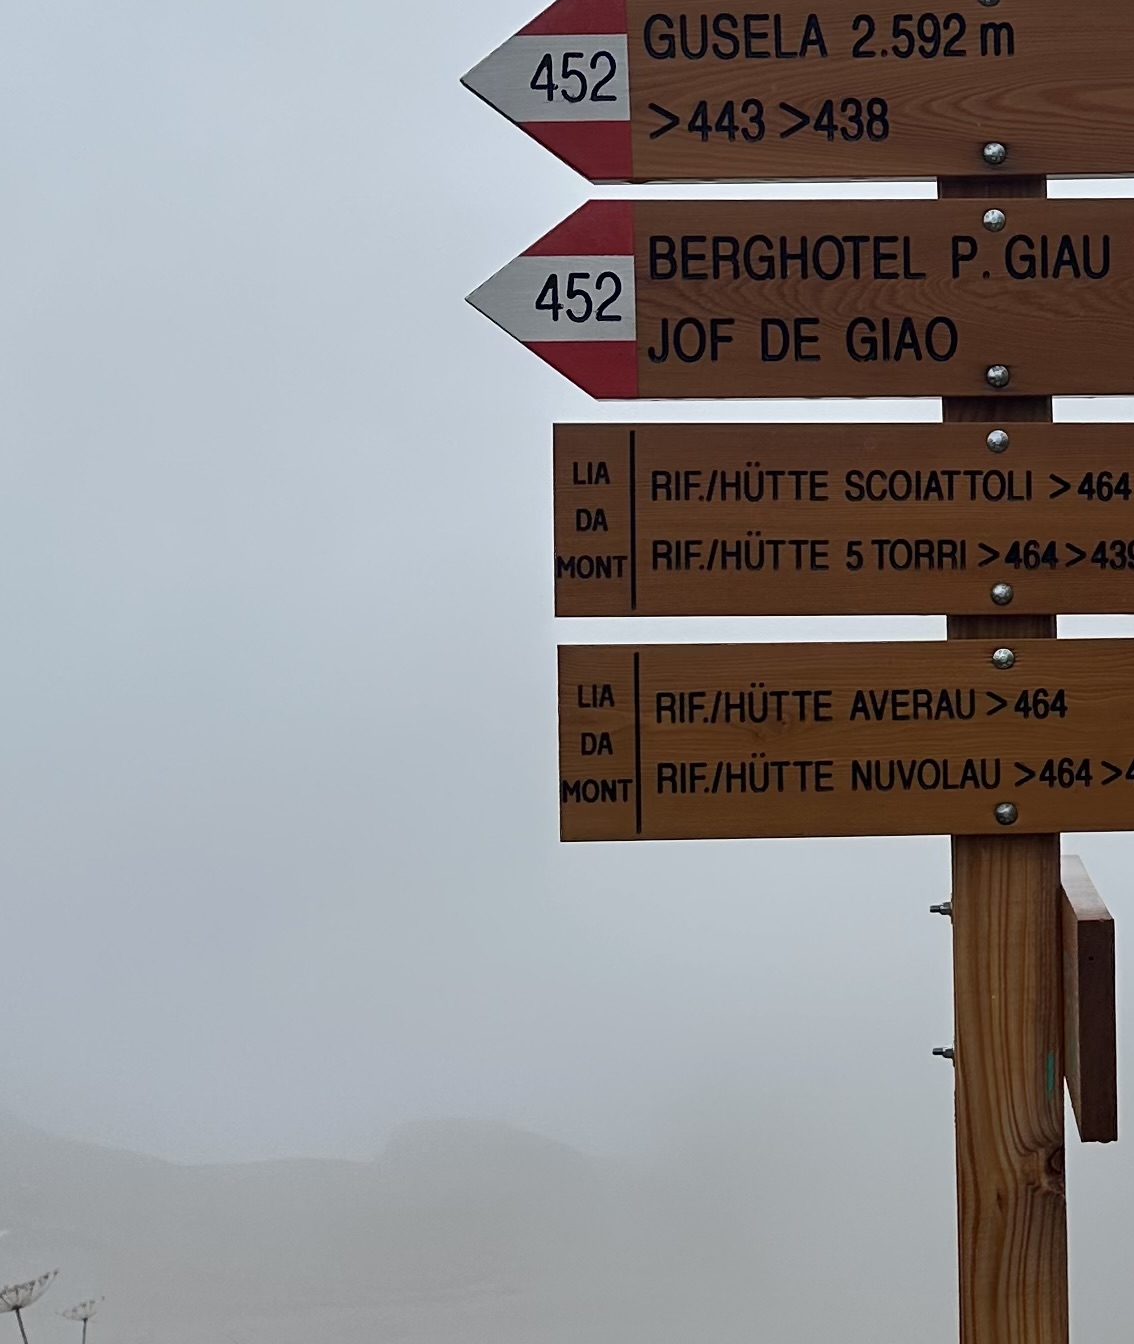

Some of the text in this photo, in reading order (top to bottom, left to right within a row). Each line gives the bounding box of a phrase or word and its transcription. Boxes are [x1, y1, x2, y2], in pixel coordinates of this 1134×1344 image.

[643, 12, 1015, 61] GUSELA 2.592 m
[530, 50, 617, 103] 452
[649, 234, 927, 281] BERGHOTEL
[1004, 234, 1110, 280] GIAU
[535, 271, 622, 324] 452
[647, 316, 958, 364] JOF DE GIAO
[572, 461, 611, 485] LIA
[651, 461, 829, 503] RIF./HÜTTE
[845, 469, 1032, 502] SCOIATTOLI
[575, 508, 609, 532] DA
[556, 555, 628, 579] MONT
[652, 530, 829, 571] RIF./HÜTTE
[846, 540, 864, 571] 5
[876, 538, 966, 571] TORRI
[577, 683, 615, 709] LIA
[655, 682, 833, 724] RIF./HÜTTE
[849, 688, 976, 721] AVERAU
[581, 731, 614, 756] DA
[561, 778, 633, 803] MONT
[657, 752, 834, 794] RIF./HÜTTE
[851, 758, 1001, 791] NUVOLAU
